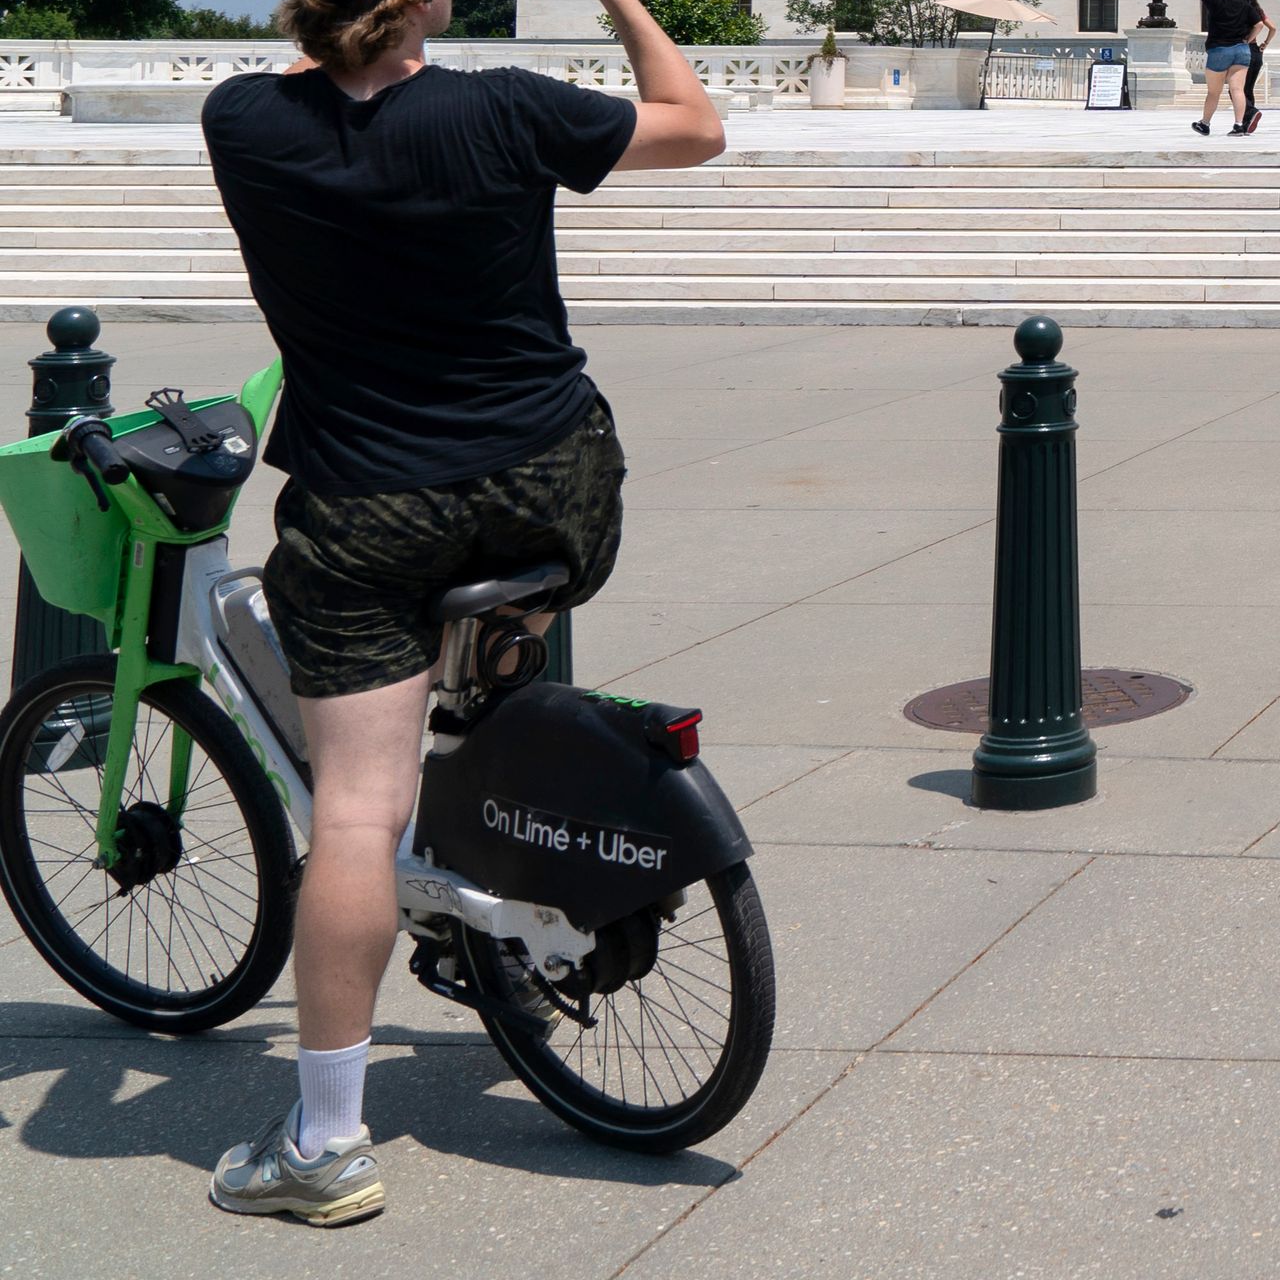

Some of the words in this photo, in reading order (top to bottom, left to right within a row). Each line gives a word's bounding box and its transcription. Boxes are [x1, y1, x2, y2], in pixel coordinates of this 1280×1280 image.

[483, 799, 510, 834] On
[513, 809, 570, 851] Lime
[598, 830, 667, 870] Uber
